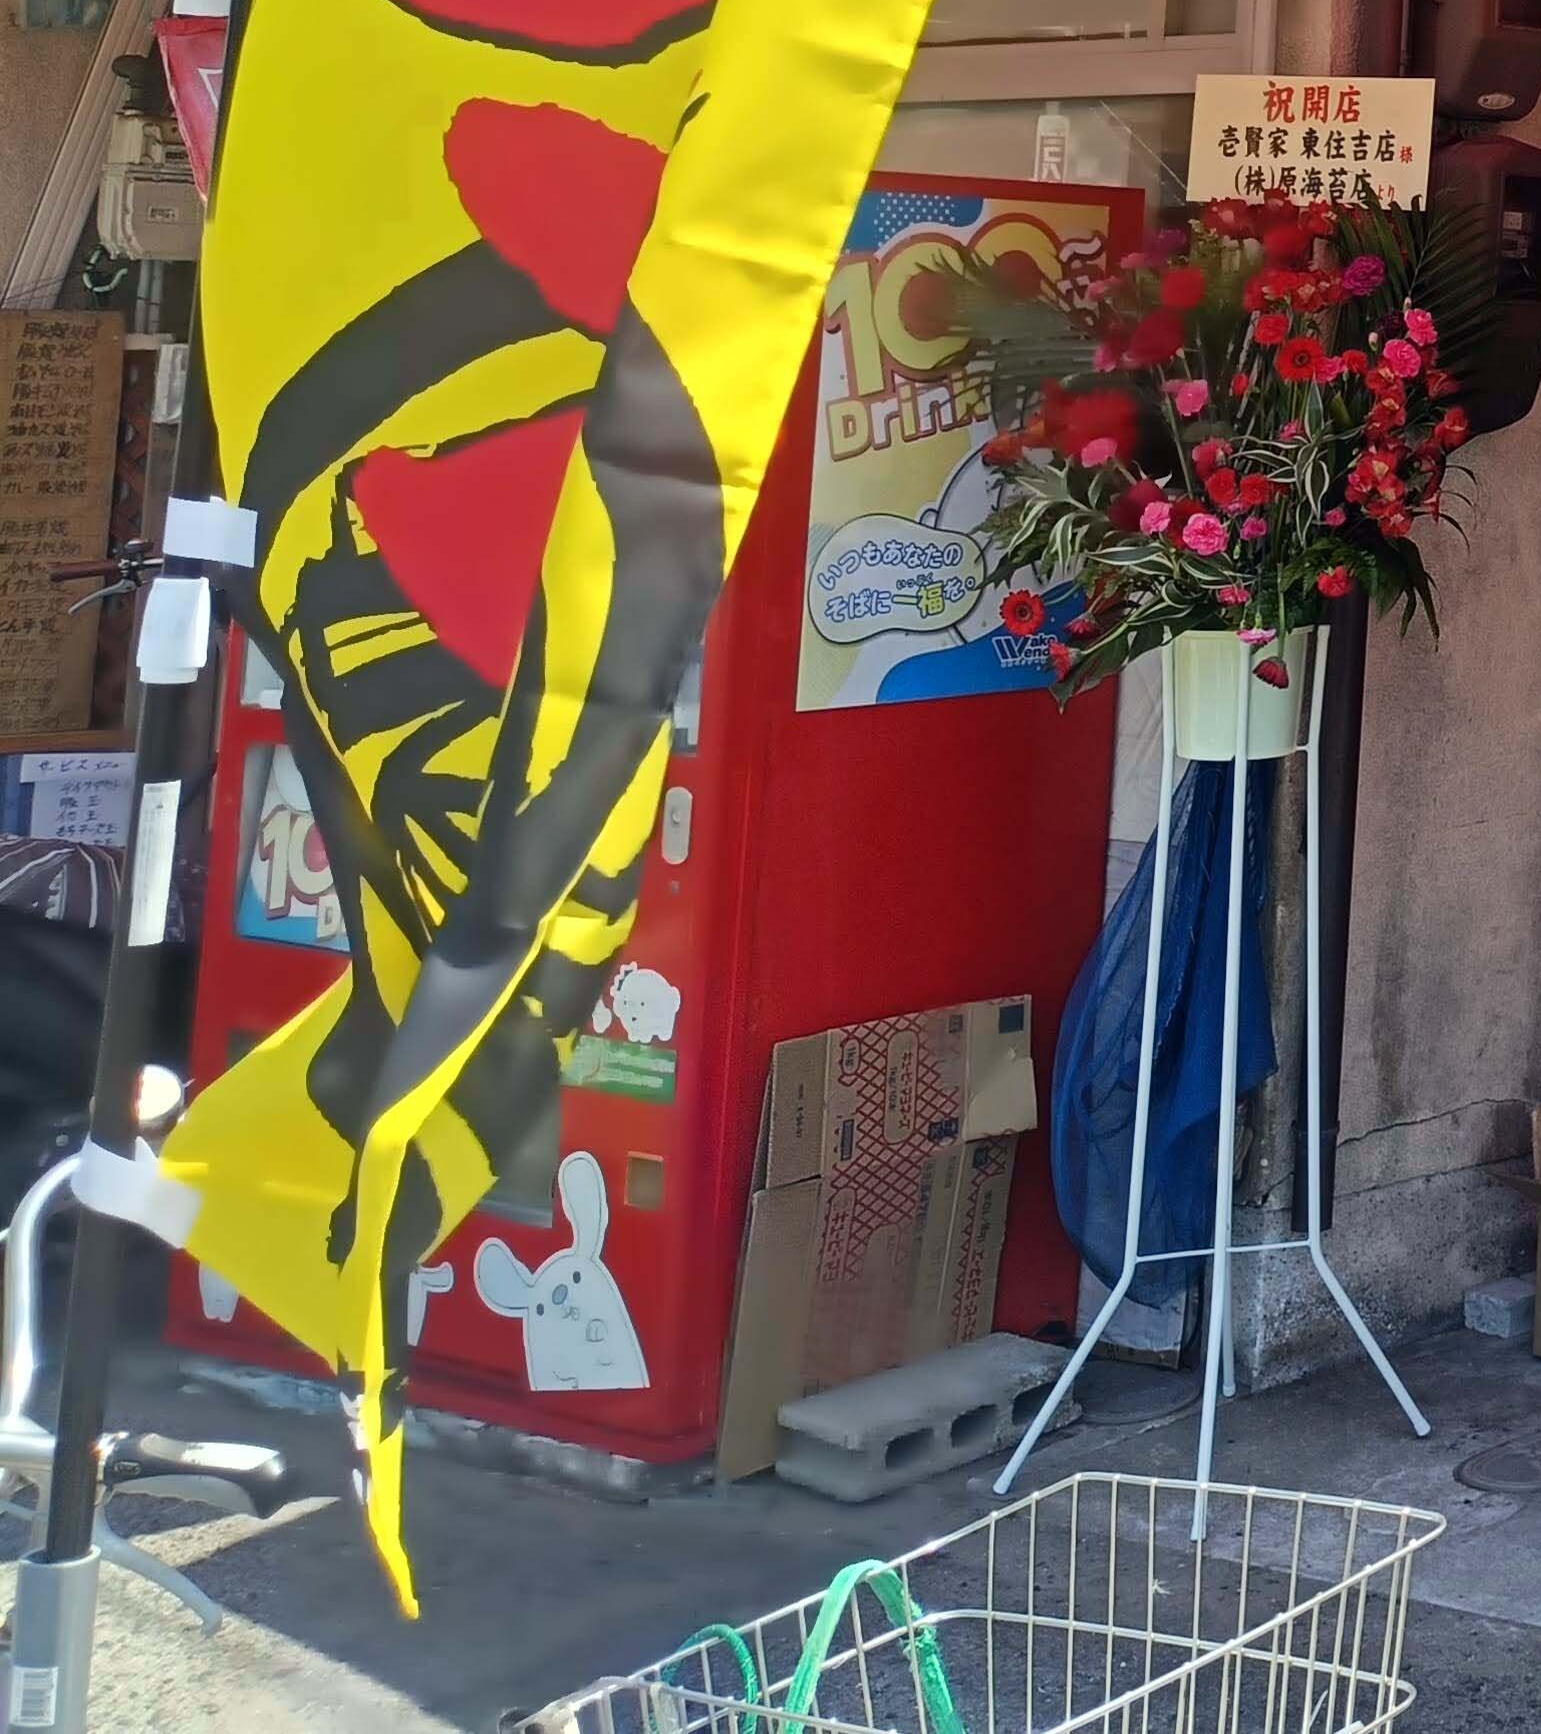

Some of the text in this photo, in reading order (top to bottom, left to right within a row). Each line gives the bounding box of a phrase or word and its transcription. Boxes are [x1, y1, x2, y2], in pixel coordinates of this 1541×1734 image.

[1263, 80, 1362, 124] 祝開店
[1218, 125, 1289, 159] 壱賢家
[1300, 127, 1396, 163] 東住吉店
[816, 541, 963, 591] いつもあなたの
[825, 575, 977, 622] そばに一福を。
